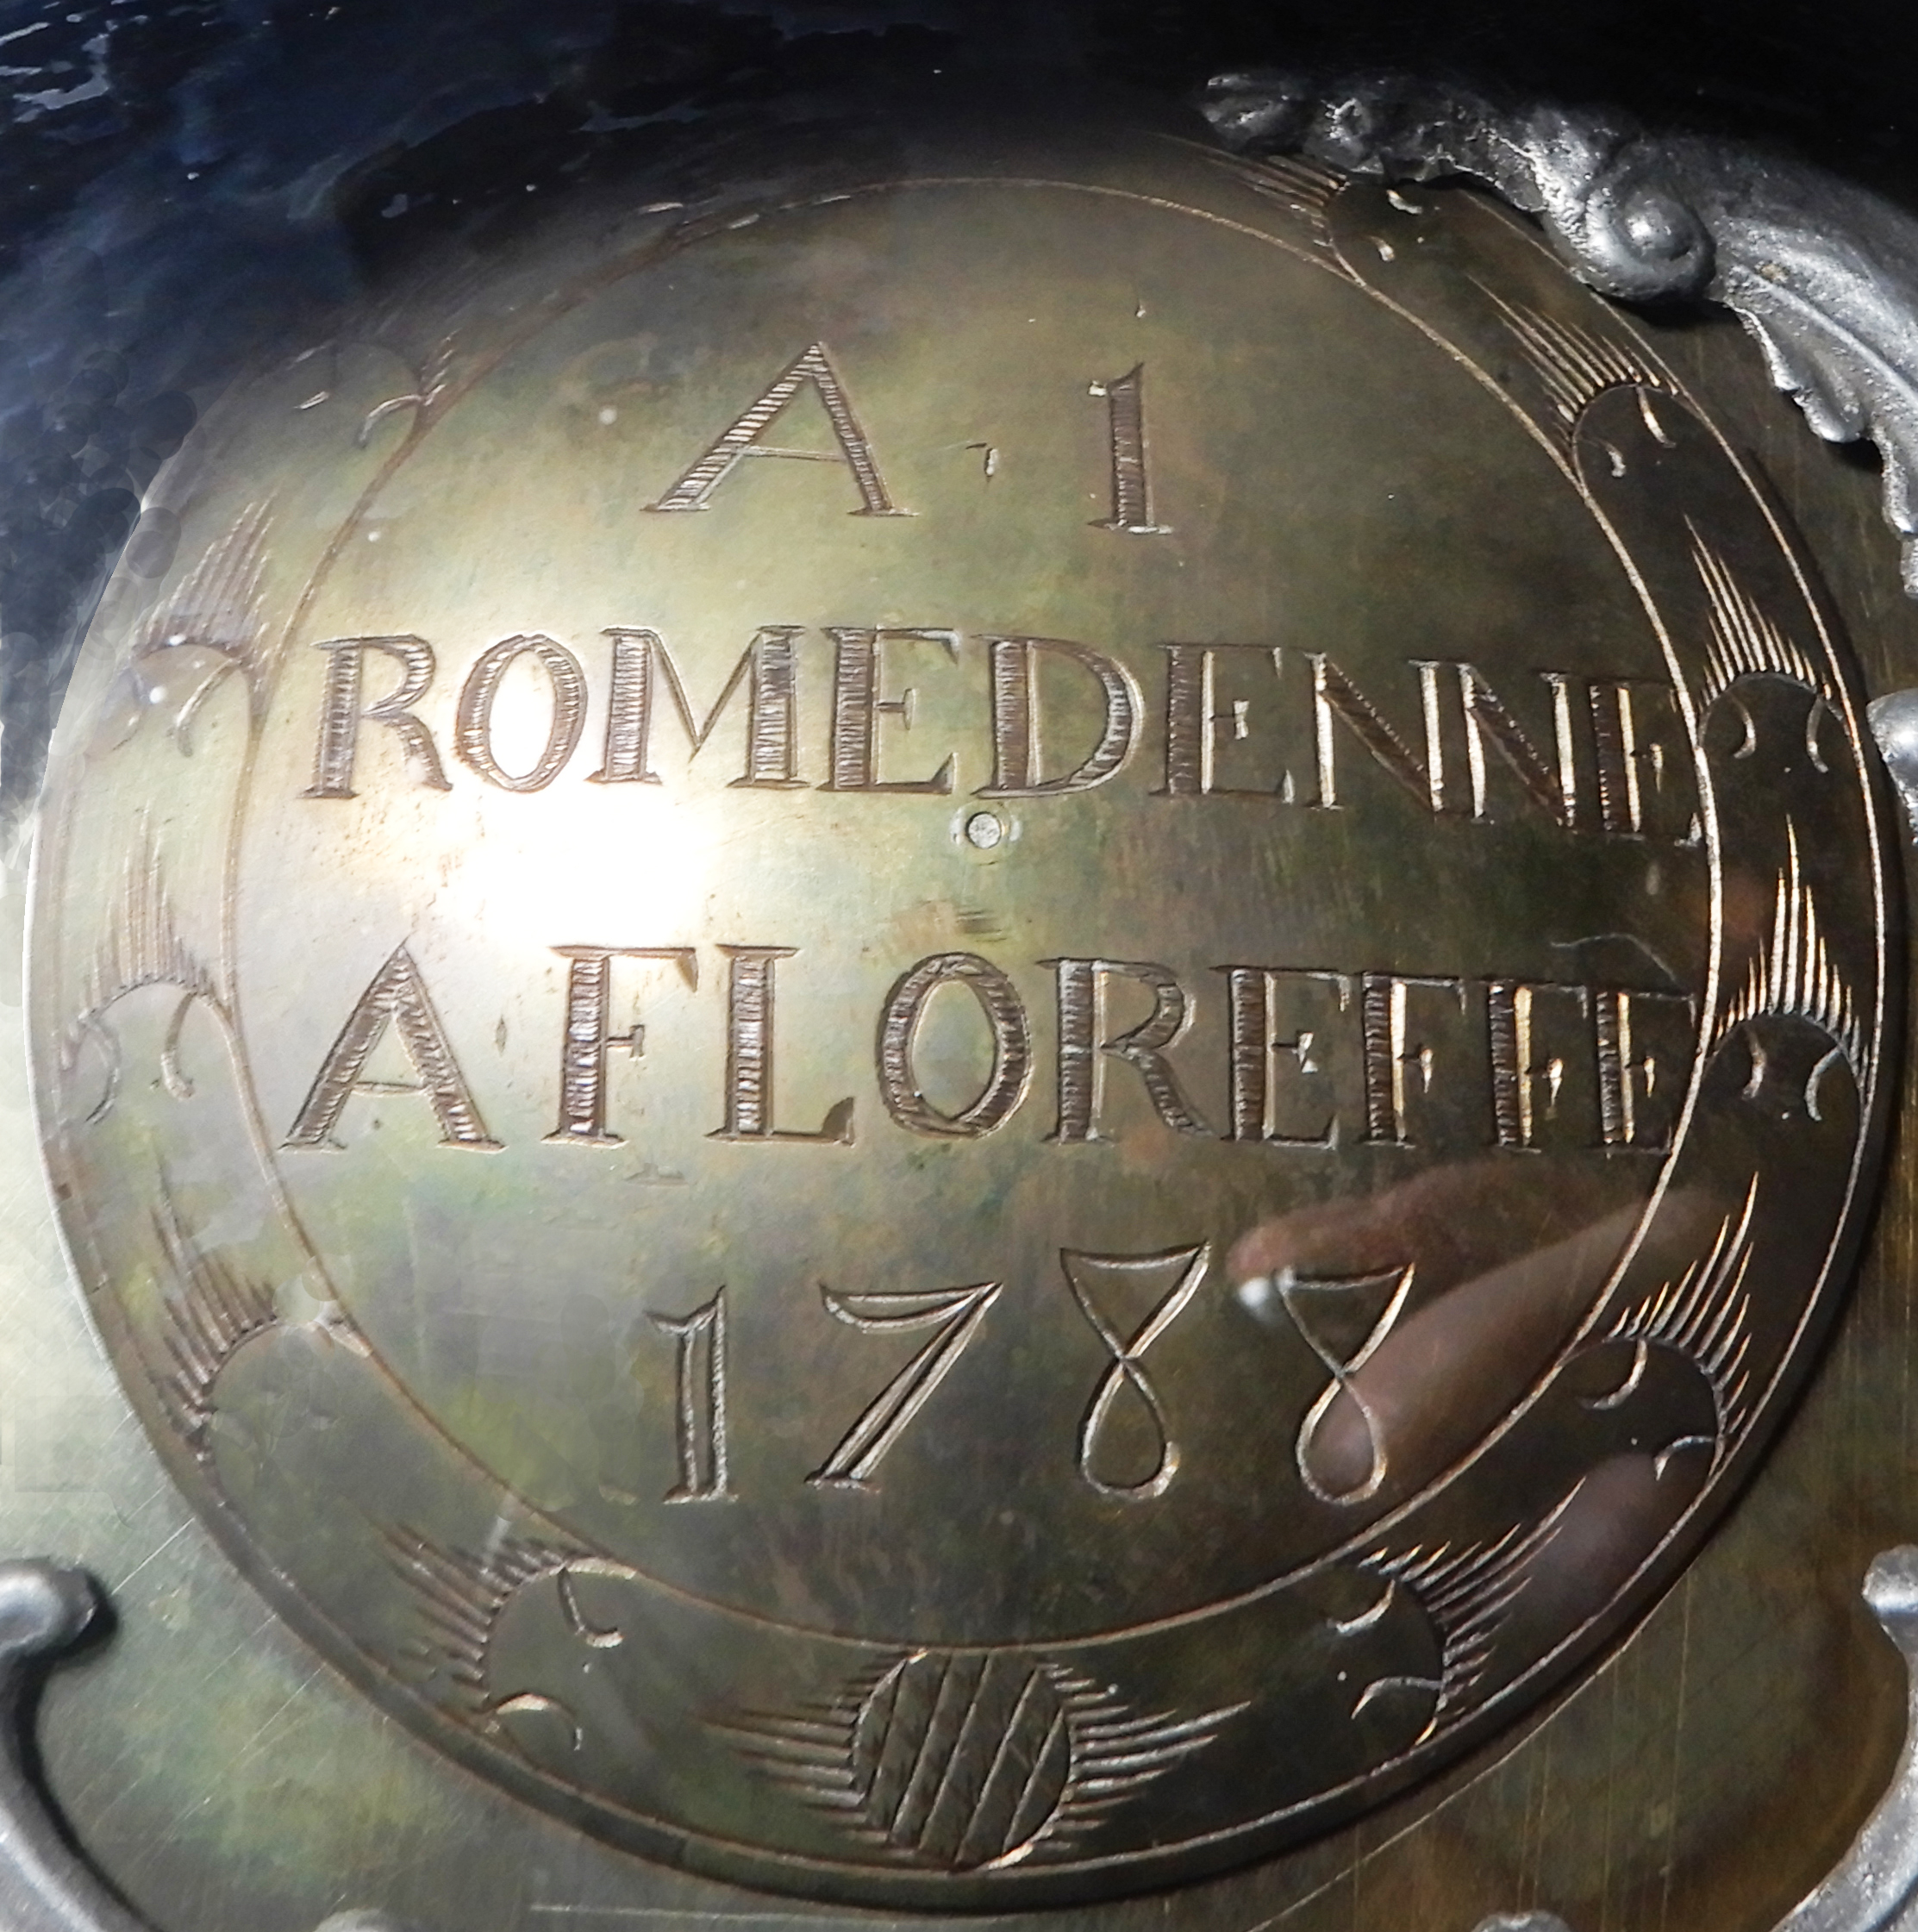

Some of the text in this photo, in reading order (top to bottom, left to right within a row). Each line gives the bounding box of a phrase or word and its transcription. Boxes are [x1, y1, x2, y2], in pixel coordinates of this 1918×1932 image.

[640, 341, 920, 517] A
[297, 625, 1703, 847] ROMEDENNE
[646, 1241, 1415, 1505] 1788
